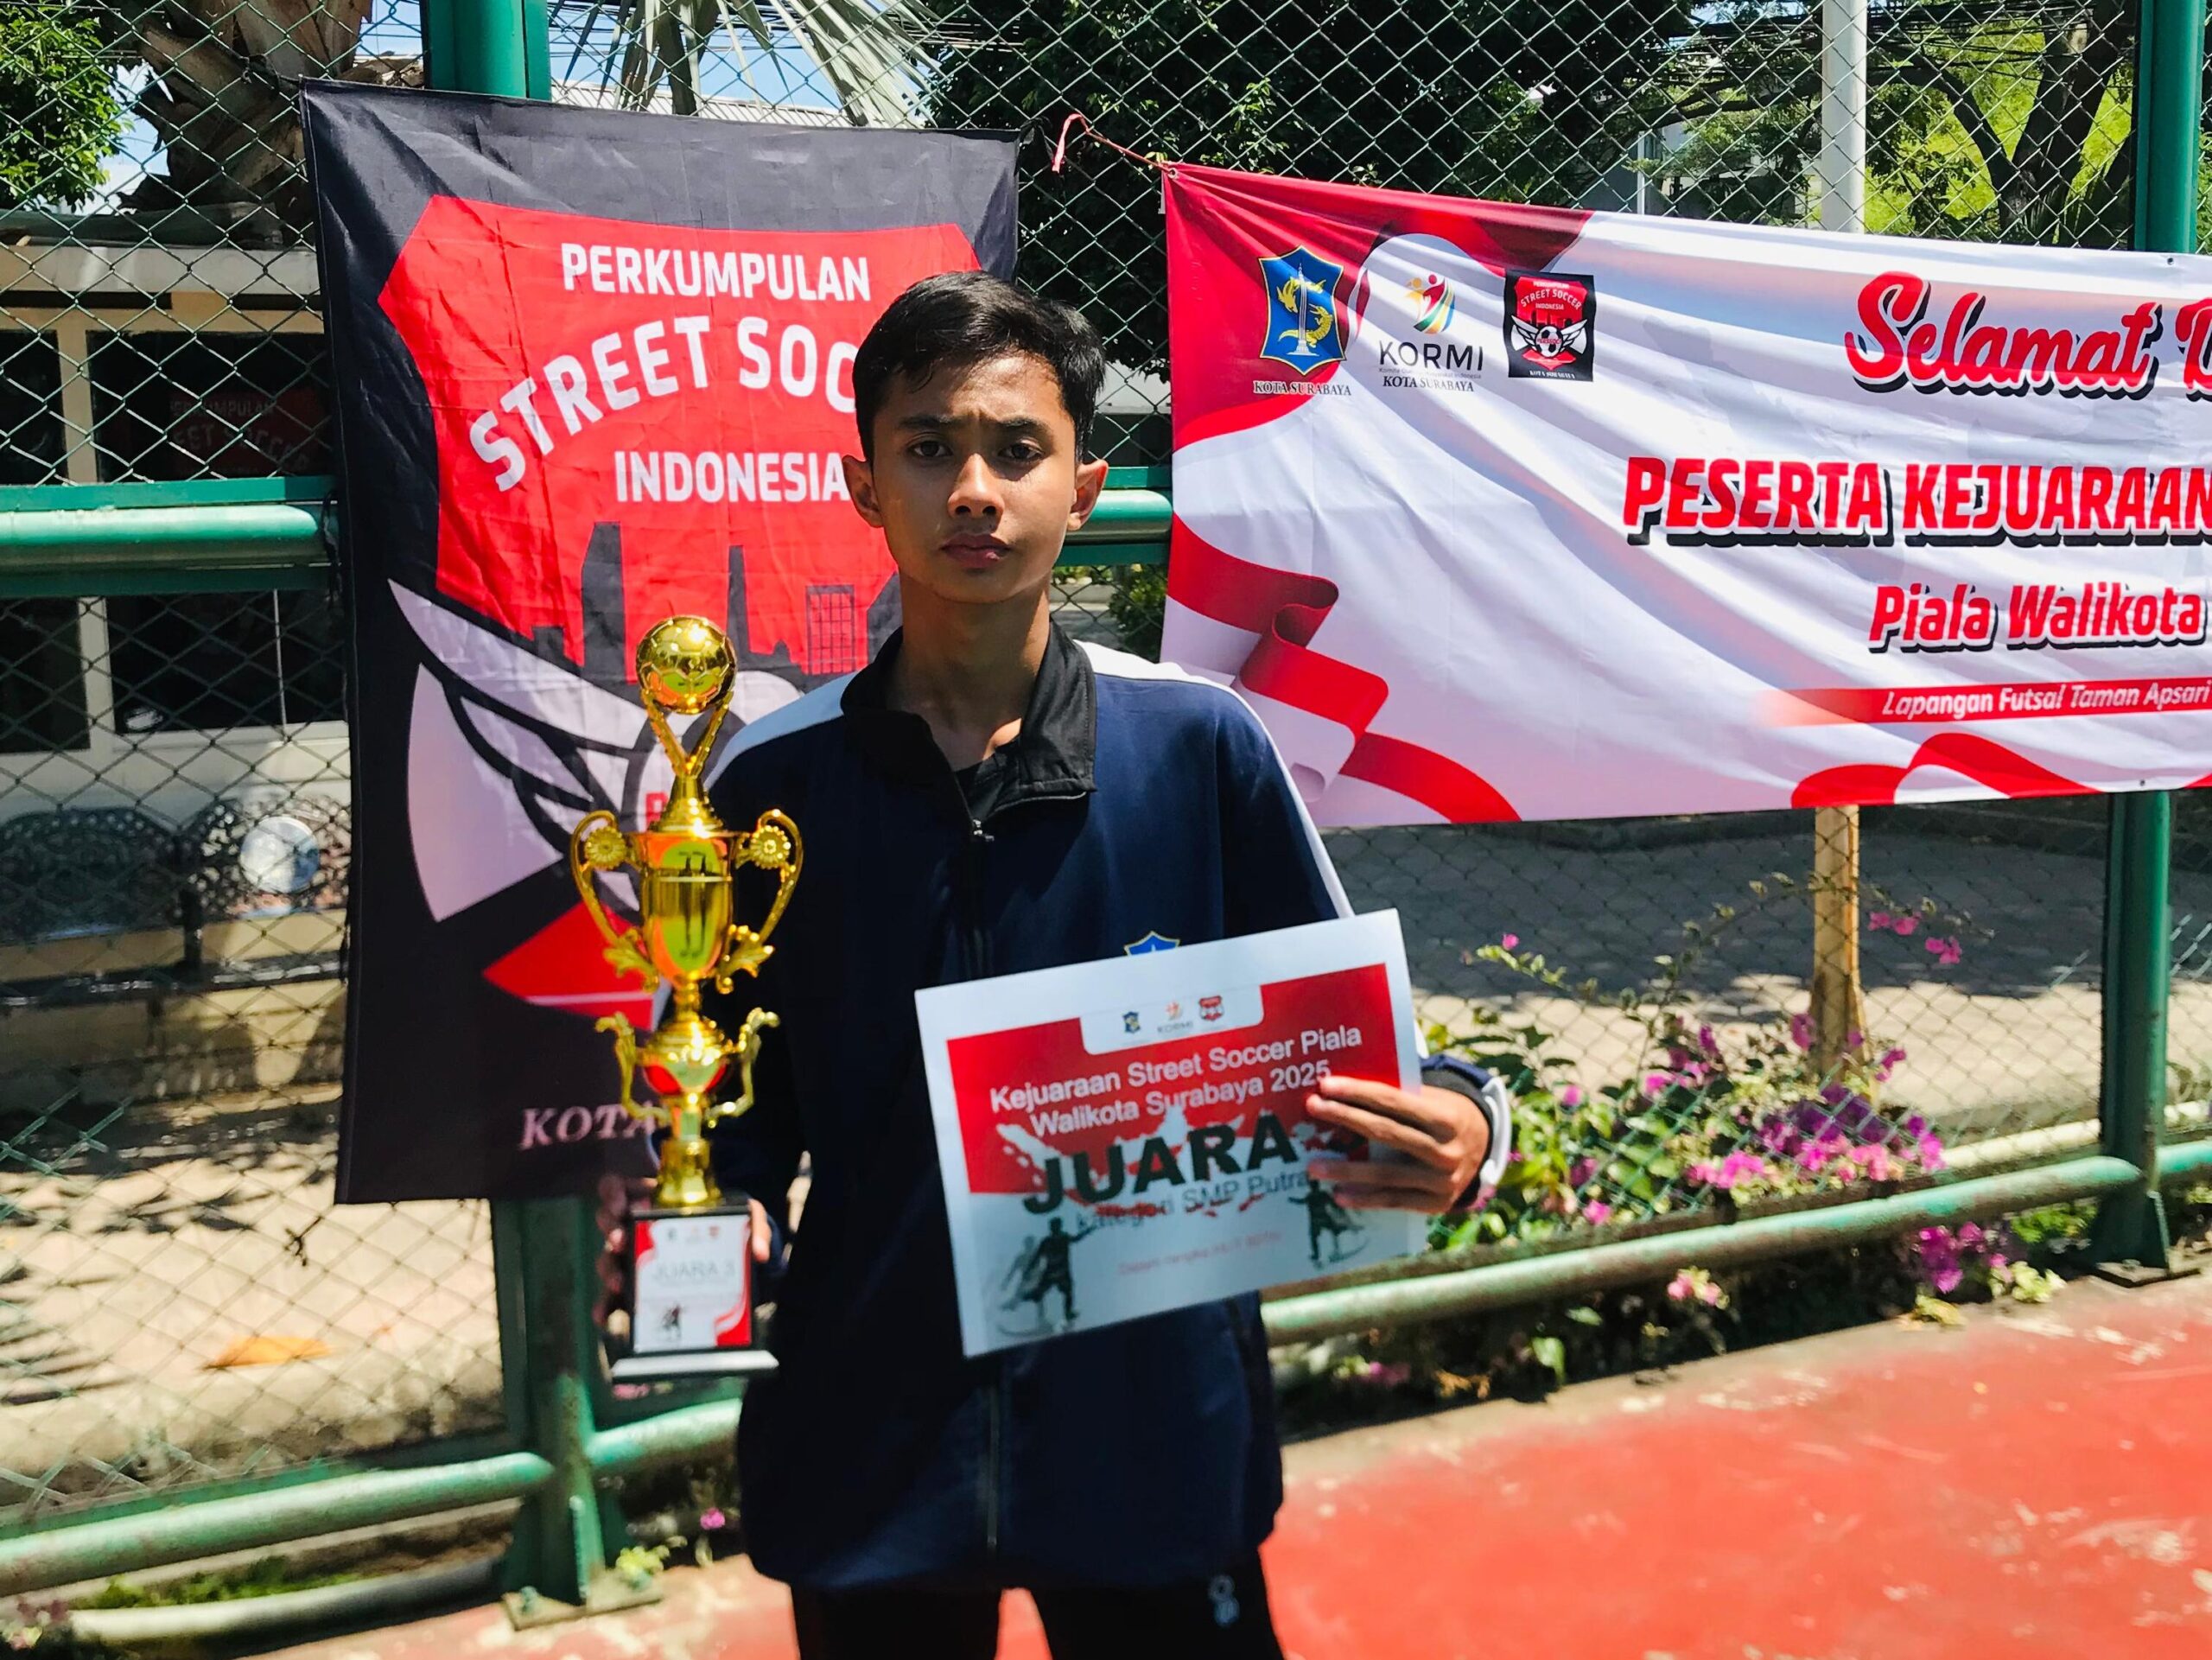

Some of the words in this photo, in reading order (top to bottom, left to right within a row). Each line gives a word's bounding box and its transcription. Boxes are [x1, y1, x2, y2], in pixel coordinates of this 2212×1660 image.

[560, 242, 871, 302] PERKUMPULAN
[1521, 289, 1550, 308] STREET
[1552, 289, 1582, 310] SOCCER
[1535, 302, 1564, 311] INDONESIA
[1379, 340, 1484, 372] KORMI
[1844, 270, 2163, 400] Selamat
[469, 315, 710, 493] STREET
[736, 316, 857, 414] SOC
[1253, 380, 1288, 395] KOTA
[1291, 380, 1351, 397] SURABAYA
[1382, 375, 1417, 388] KOTA
[1420, 376, 1474, 392] SURABAYA
[614, 451, 852, 503] INDONESIA
[1624, 456, 1894, 547] PESERTA
[1904, 464, 2212, 547] KEJUARAAN
[1868, 582, 1999, 654] Piala
[2005, 580, 2209, 651] Walikota
[1882, 691, 1993, 719] Lapangan
[1999, 684, 2066, 712] Futsal
[2070, 685, 2139, 709] Taman
[2143, 679, 2211, 709] Apsari
[990, 1072, 1122, 1114] Kejuaraan
[1128, 1053, 1204, 1087] Street
[1209, 1038, 1294, 1072] Soccer
[1300, 1024, 1363, 1054] Piala
[518, 1100, 657, 1150] KOTA
[1030, 1099, 1140, 1138] Walikota
[1145, 1076, 1264, 1116] Surabaya
[1270, 1059, 1332, 1092] 2025
[1023, 1114, 1300, 1215] JUARA
